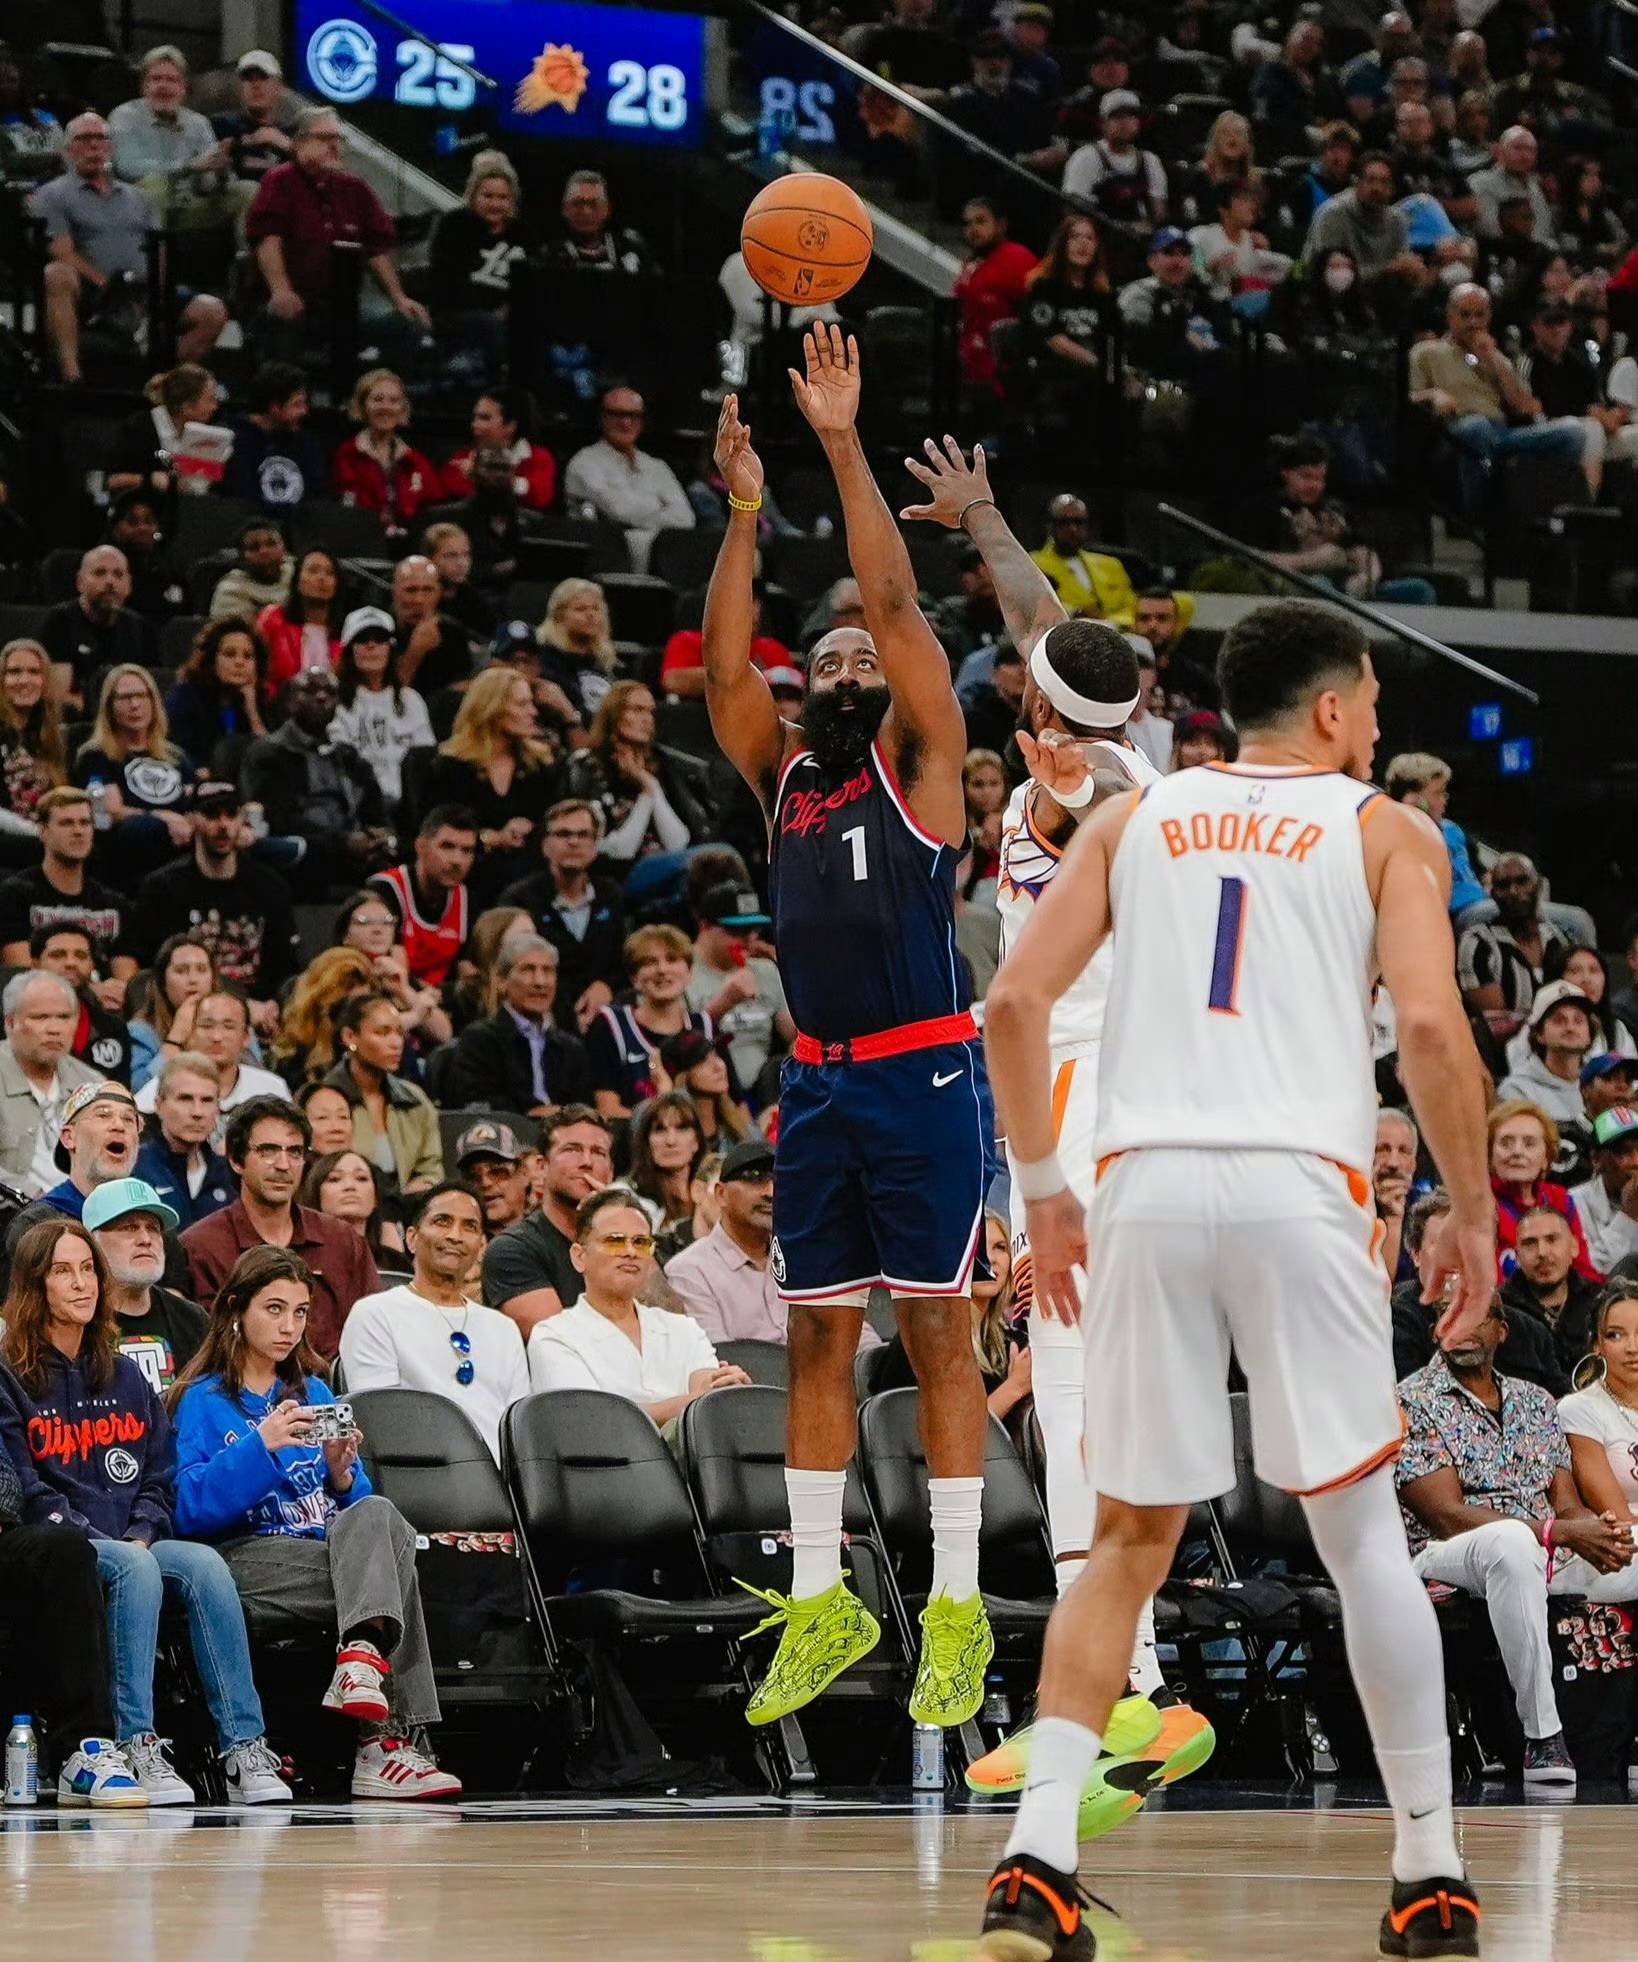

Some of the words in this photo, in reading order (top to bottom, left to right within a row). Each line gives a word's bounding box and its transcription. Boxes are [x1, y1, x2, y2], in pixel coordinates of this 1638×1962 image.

[395, 39, 475, 109] 25
[607, 60, 687, 130] 28
[842, 825, 868, 881] 1
[1160, 811, 1325, 863] BOOKER
[1207, 876, 1248, 1016] 1
[28, 1411, 145, 1466] Clippers
